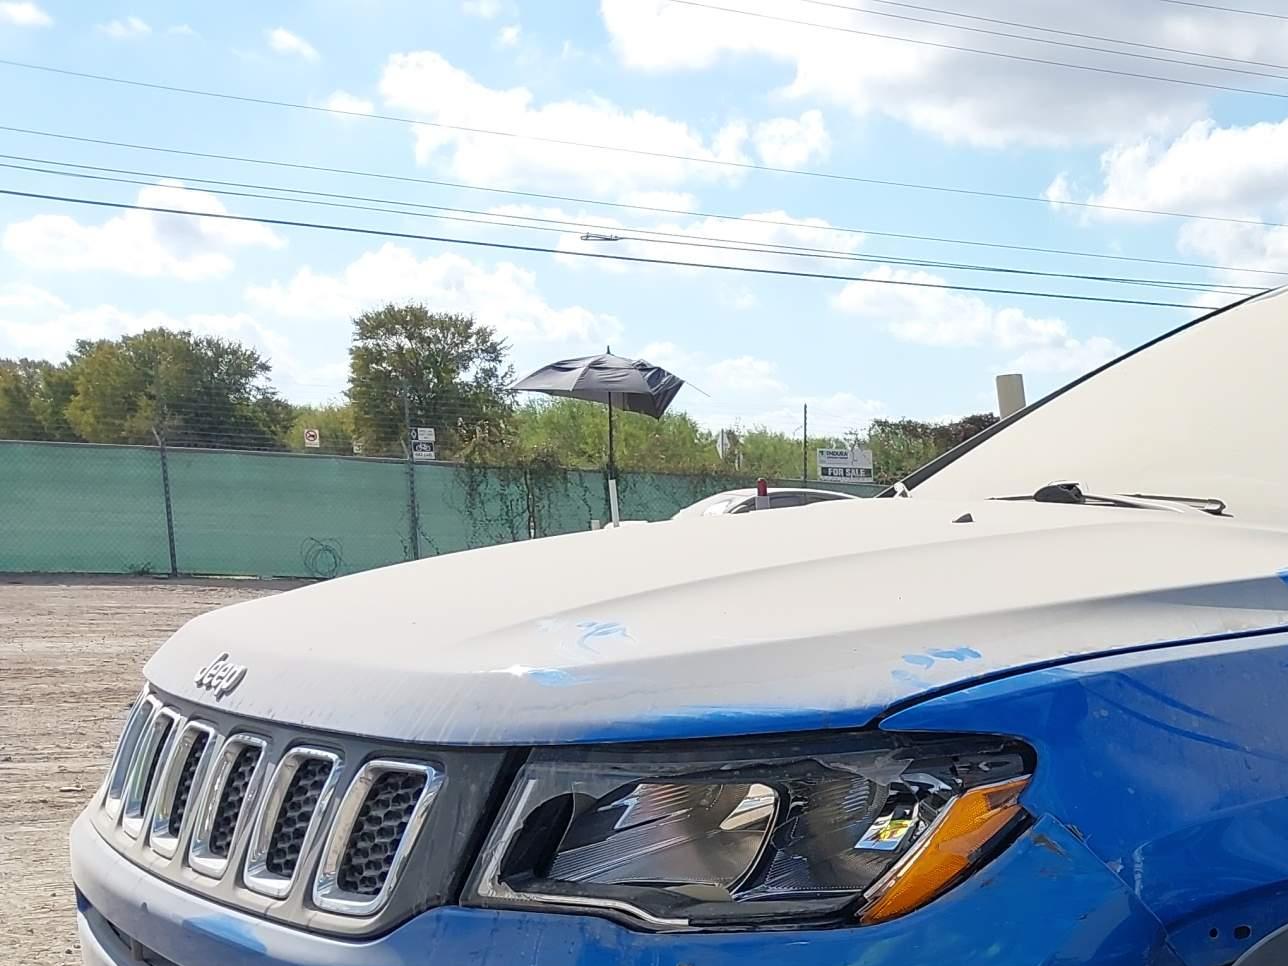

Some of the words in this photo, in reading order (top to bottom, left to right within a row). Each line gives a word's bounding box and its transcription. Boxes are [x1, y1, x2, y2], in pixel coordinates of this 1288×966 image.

[828, 467, 844, 476] FOR
[845, 468, 865, 477] SALE
[194, 652, 248, 703] Jeep
